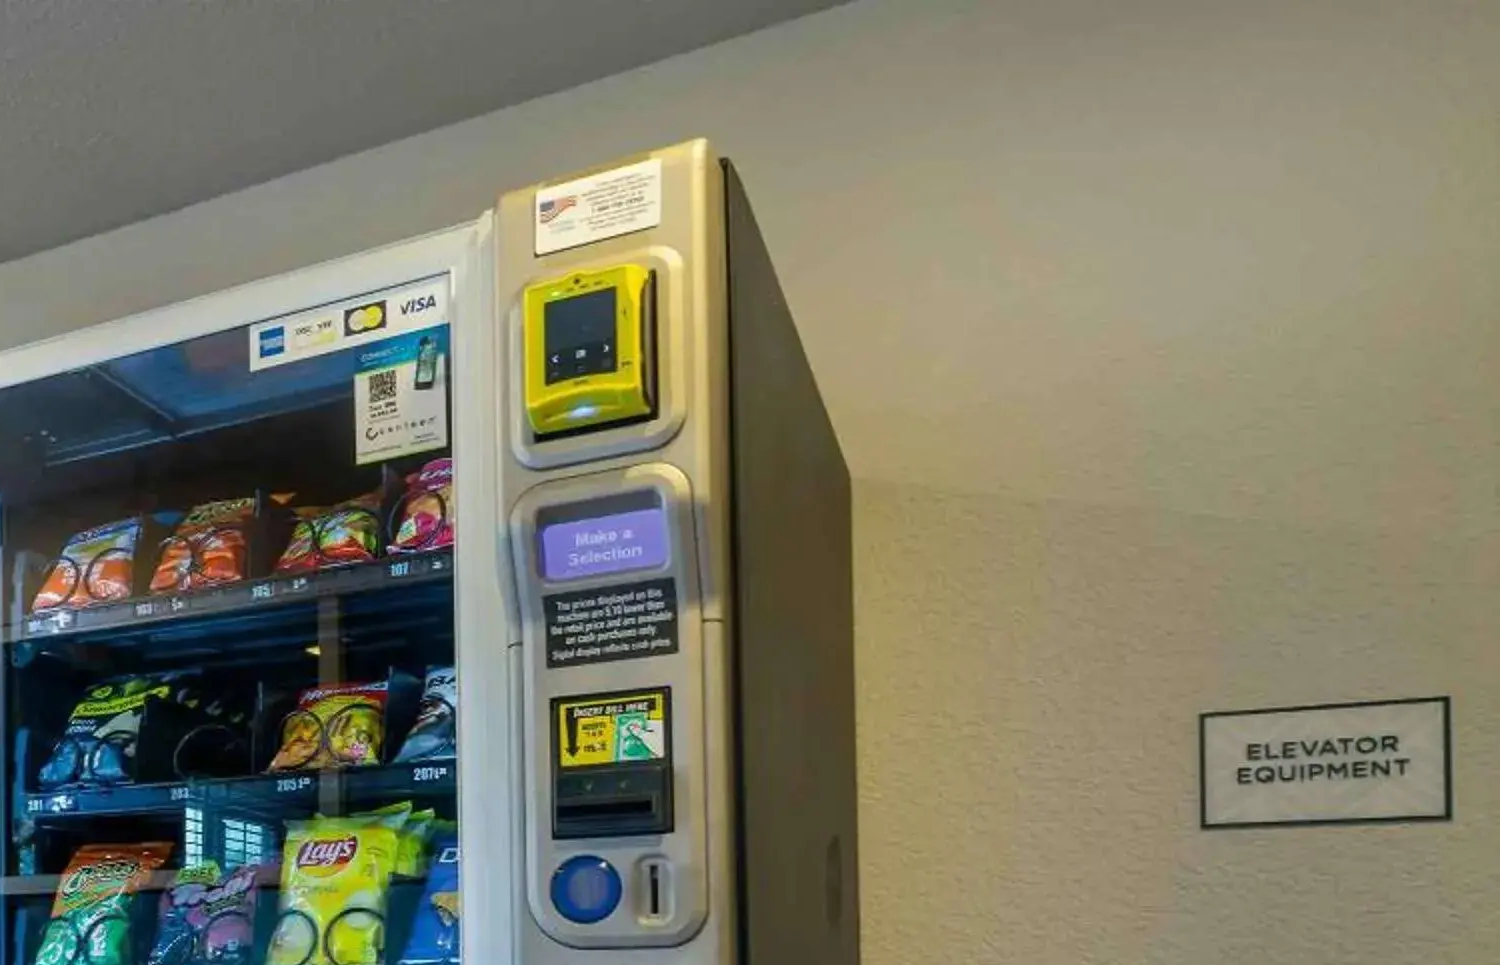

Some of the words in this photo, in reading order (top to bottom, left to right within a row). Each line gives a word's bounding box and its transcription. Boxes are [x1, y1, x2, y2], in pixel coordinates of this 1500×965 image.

[400, 295, 437, 315] VISA
[575, 529, 617, 547] Make
[568, 546, 643, 567] Selection
[1246, 735, 1400, 761] ELEVATOR
[1236, 758, 1411, 785] EQUIPMENT
[298, 835, 356, 867] Lay's
